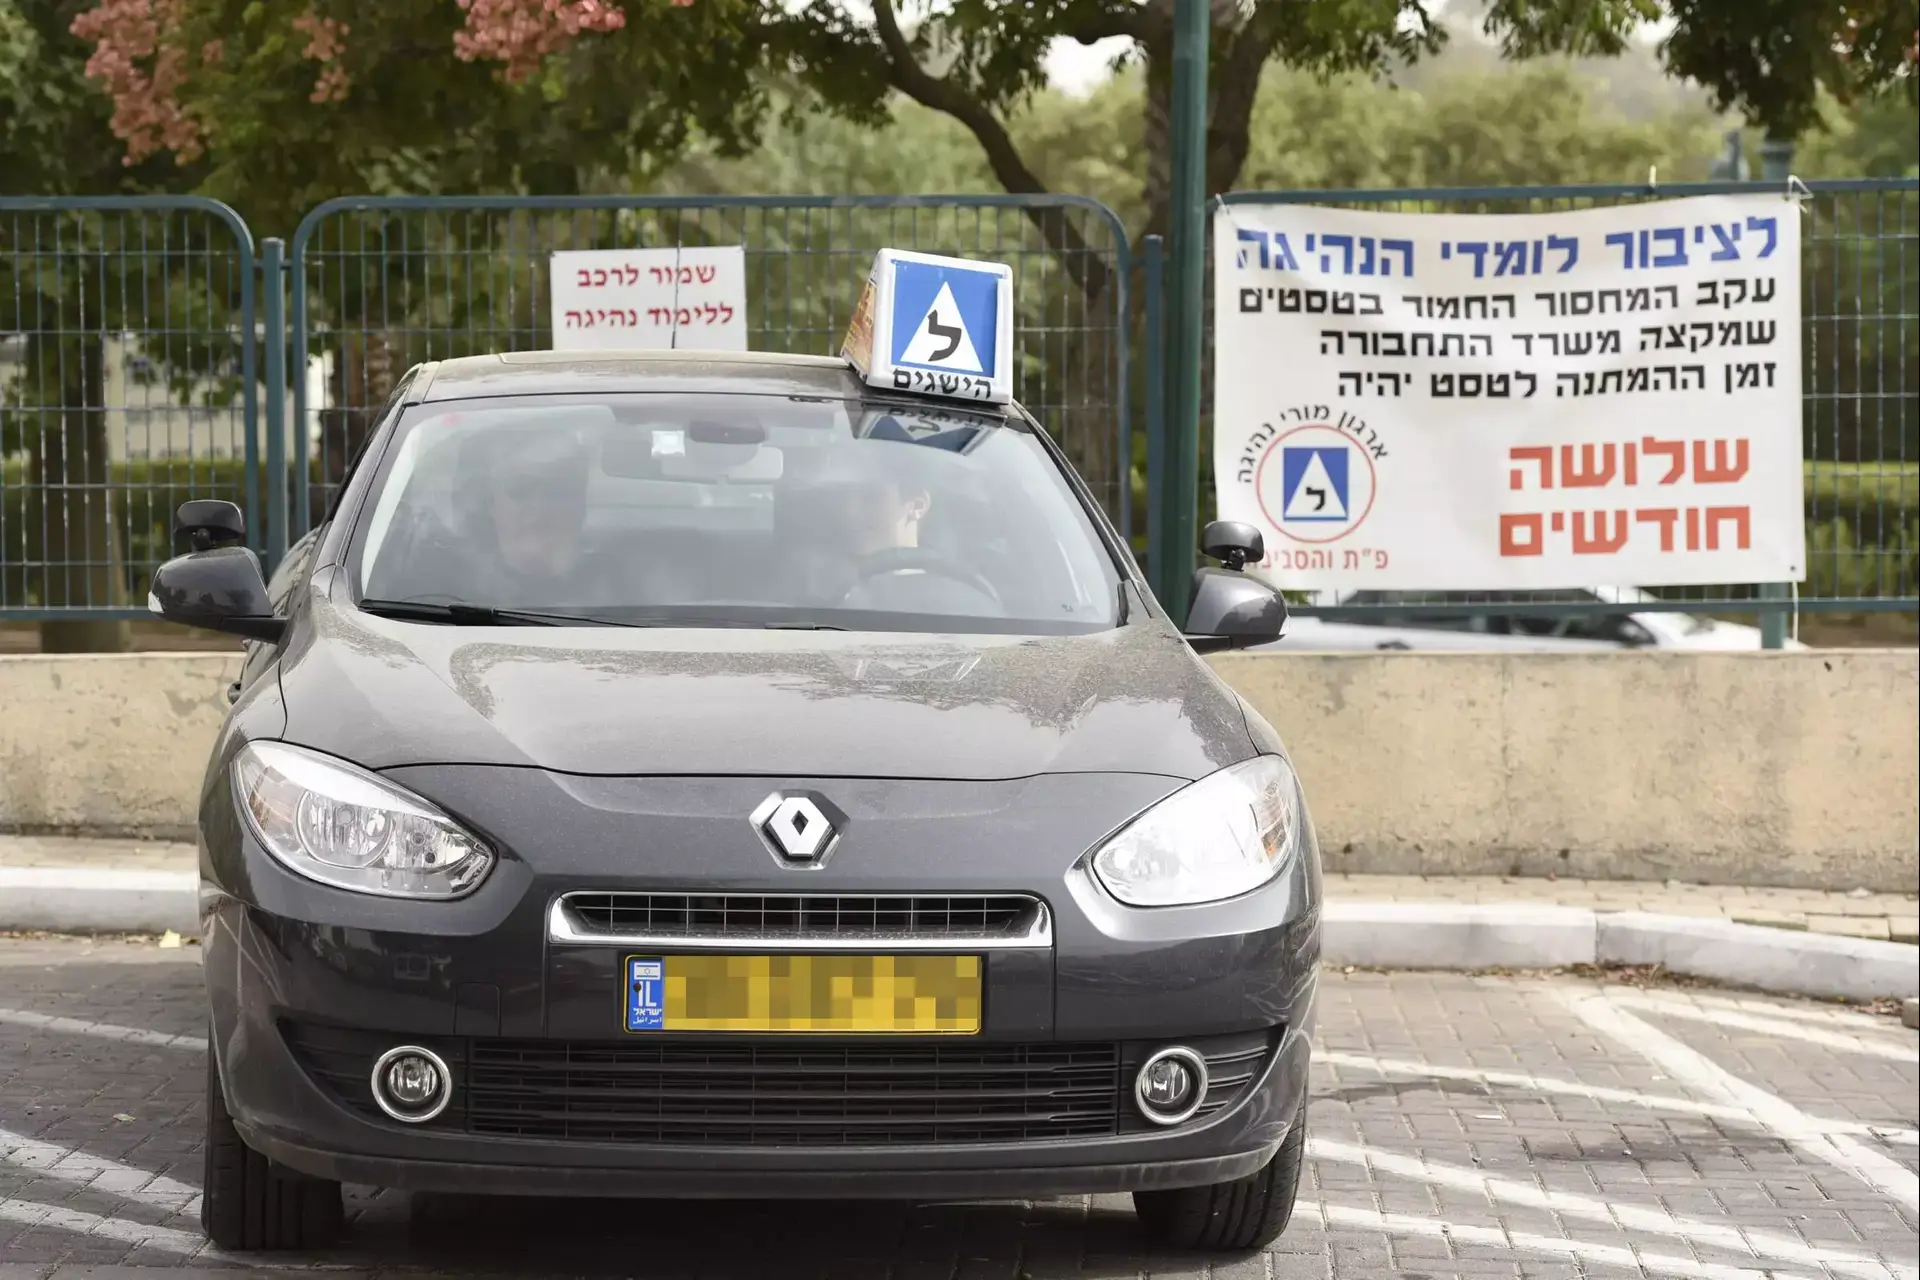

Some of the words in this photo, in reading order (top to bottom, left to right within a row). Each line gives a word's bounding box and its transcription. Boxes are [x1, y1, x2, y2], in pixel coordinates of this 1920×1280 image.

[1236, 228, 1415, 277] הנהיגה
[1440, 233, 1579, 278] לומדי
[1604, 216, 1778, 270] לציבור
[577, 262, 639, 288] לרכב
[649, 264, 716, 285] שמור
[1239, 287, 1384, 315] בטסטים
[1402, 294, 1516, 320] החמור
[1535, 285, 1679, 317] המחסור
[1696, 278, 1775, 310] עקב
[565, 306, 638, 329] נהיגה
[647, 301, 734, 326] ללימוד
[926, 308, 963, 362] ל
[1320, 330, 1493, 356] התחבורה
[1512, 329, 1621, 356] משרד
[1640, 320, 1776, 353] שמקצה
[892, 367, 992, 399] הישגים
[1338, 372, 1412, 397] יהיה
[1430, 370, 1538, 398] לטסט
[1557, 365, 1705, 397] ההמתנה
[1725, 361, 1777, 394] זמן
[1280, 404, 1330, 422] מורי
[1338, 411, 1389, 460] ארגון
[1237, 422, 1277, 484] נהיגה
[1509, 436, 1750, 490] שלושה
[1499, 506, 1752, 557] חודשים
[637, 980, 657, 1007] IL
[632, 1007, 662, 1016] ישראל
